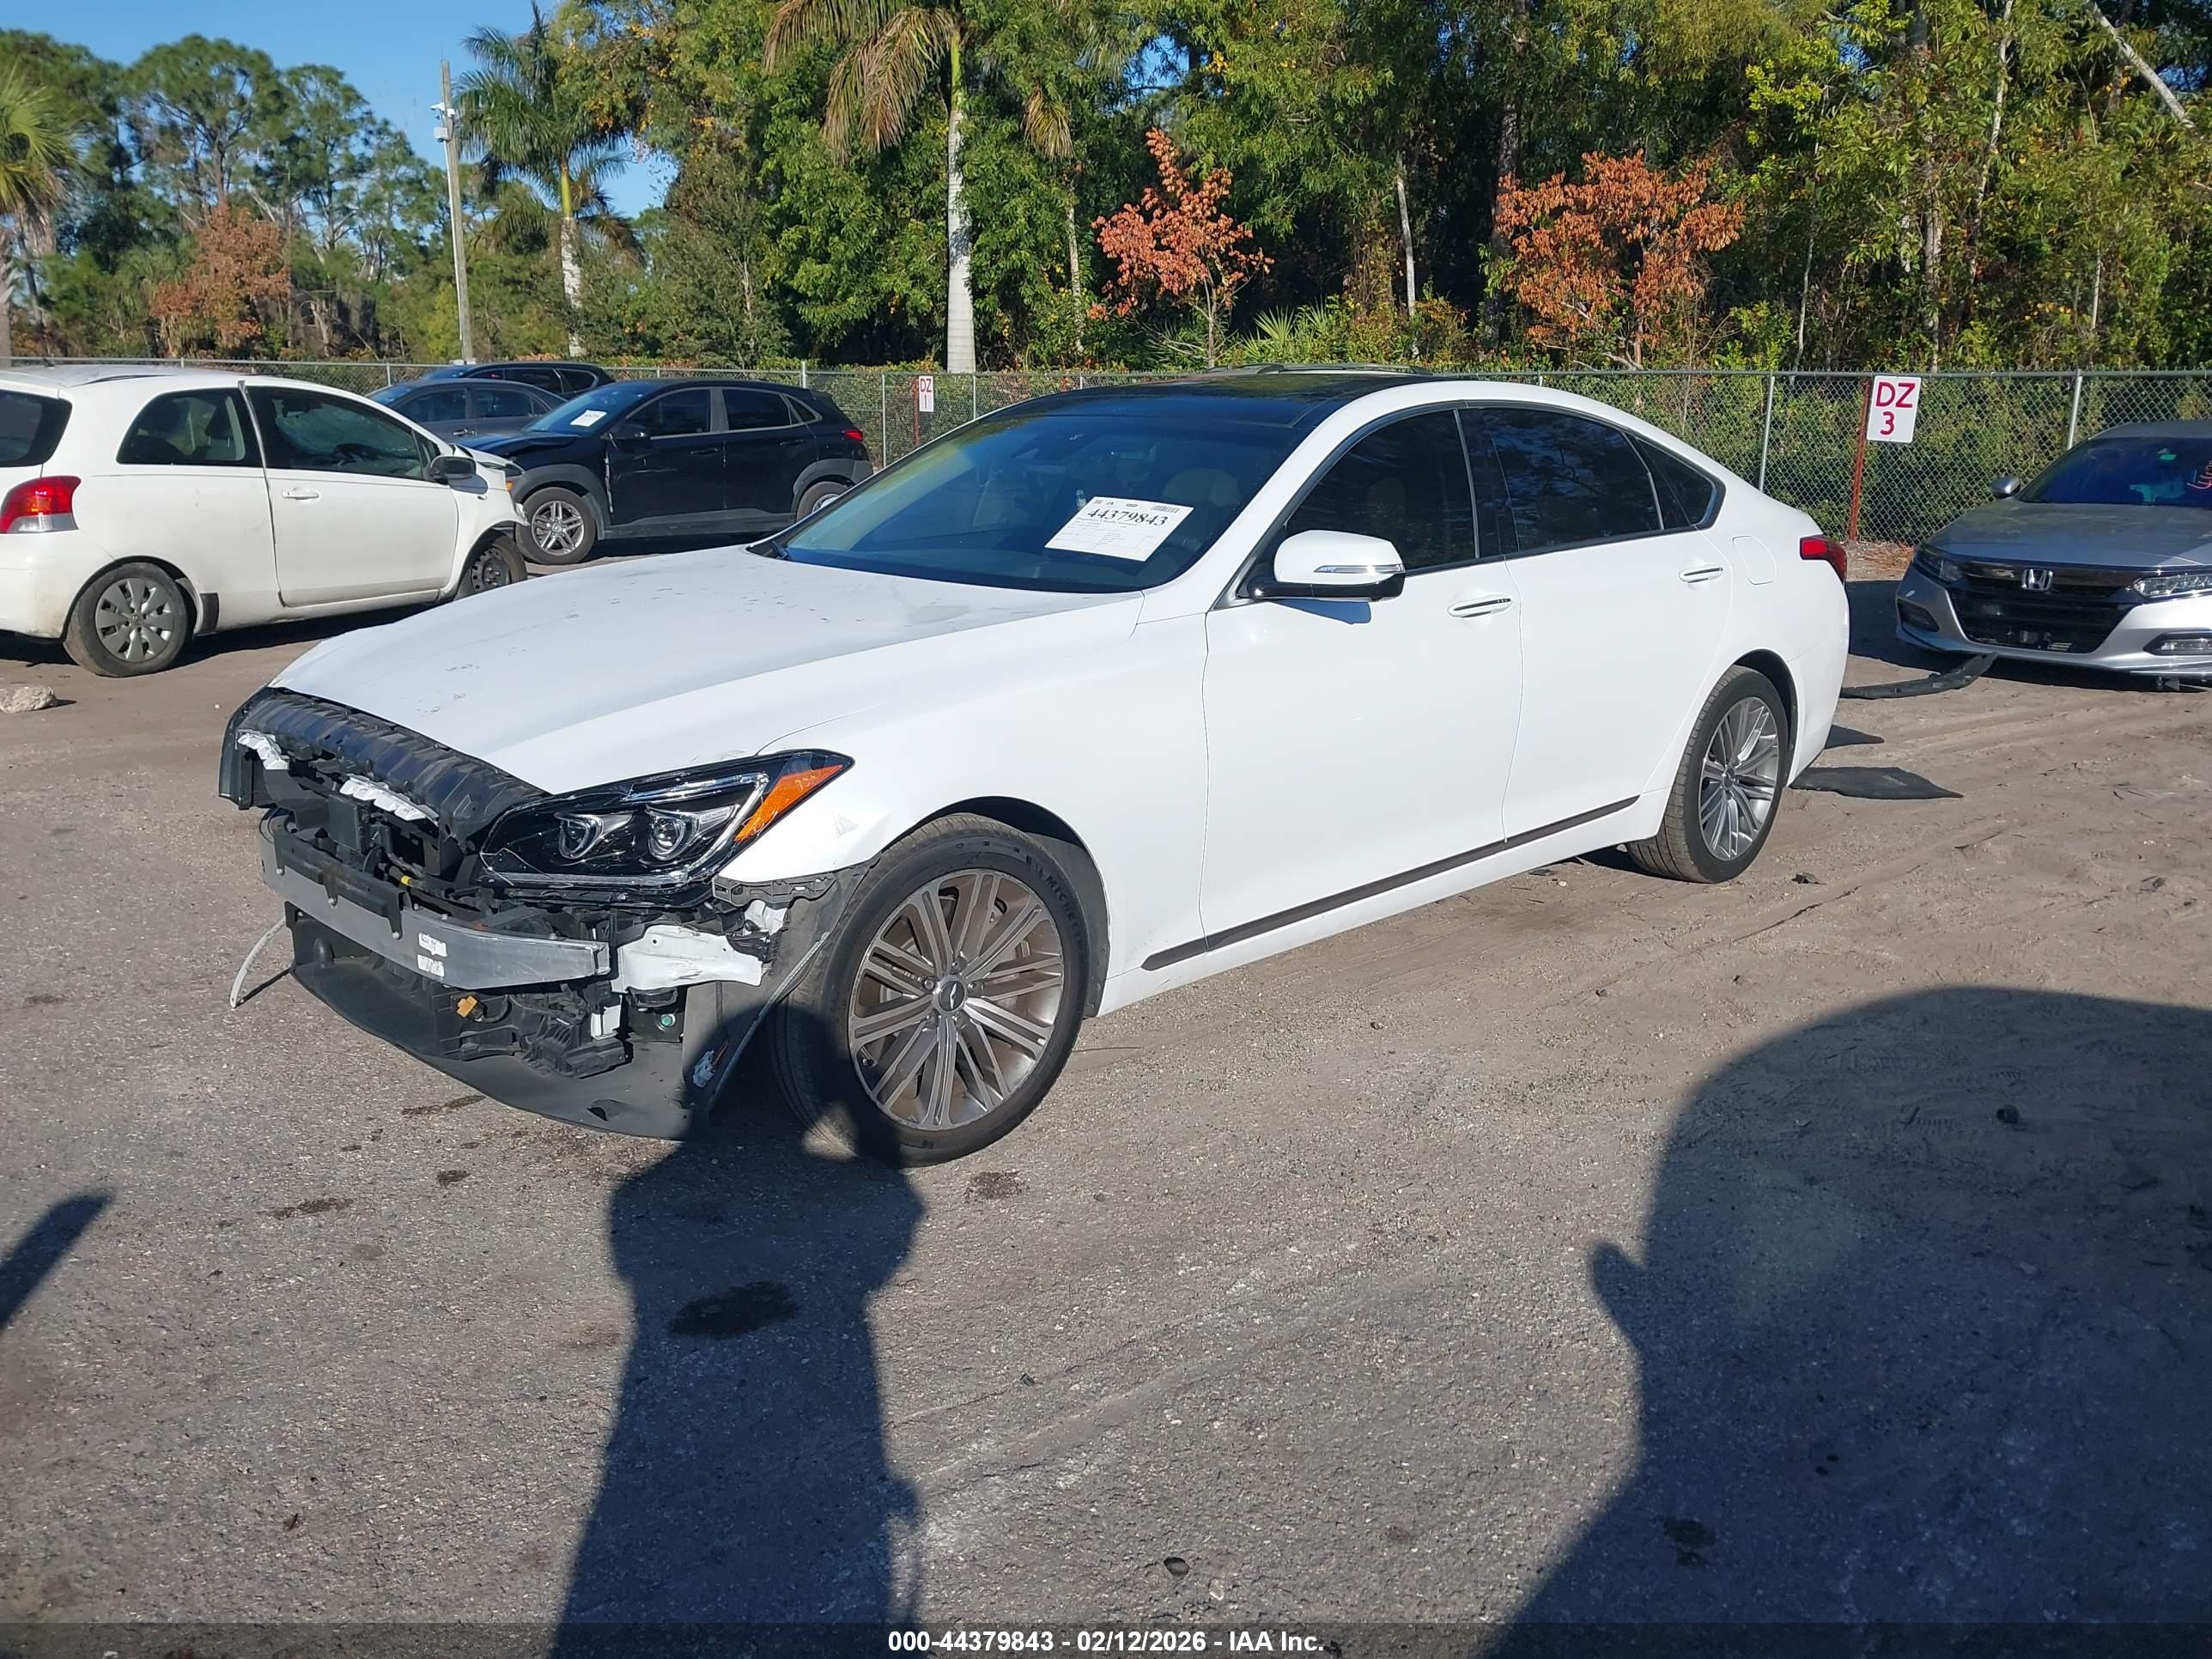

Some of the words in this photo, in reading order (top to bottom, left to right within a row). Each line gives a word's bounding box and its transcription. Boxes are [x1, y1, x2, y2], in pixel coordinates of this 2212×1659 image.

[920, 378, 933, 392] DZ
[1875, 381, 1916, 408] DZ
[1880, 410, 1895, 435] 3
[1087, 507, 1169, 526] 44379843
